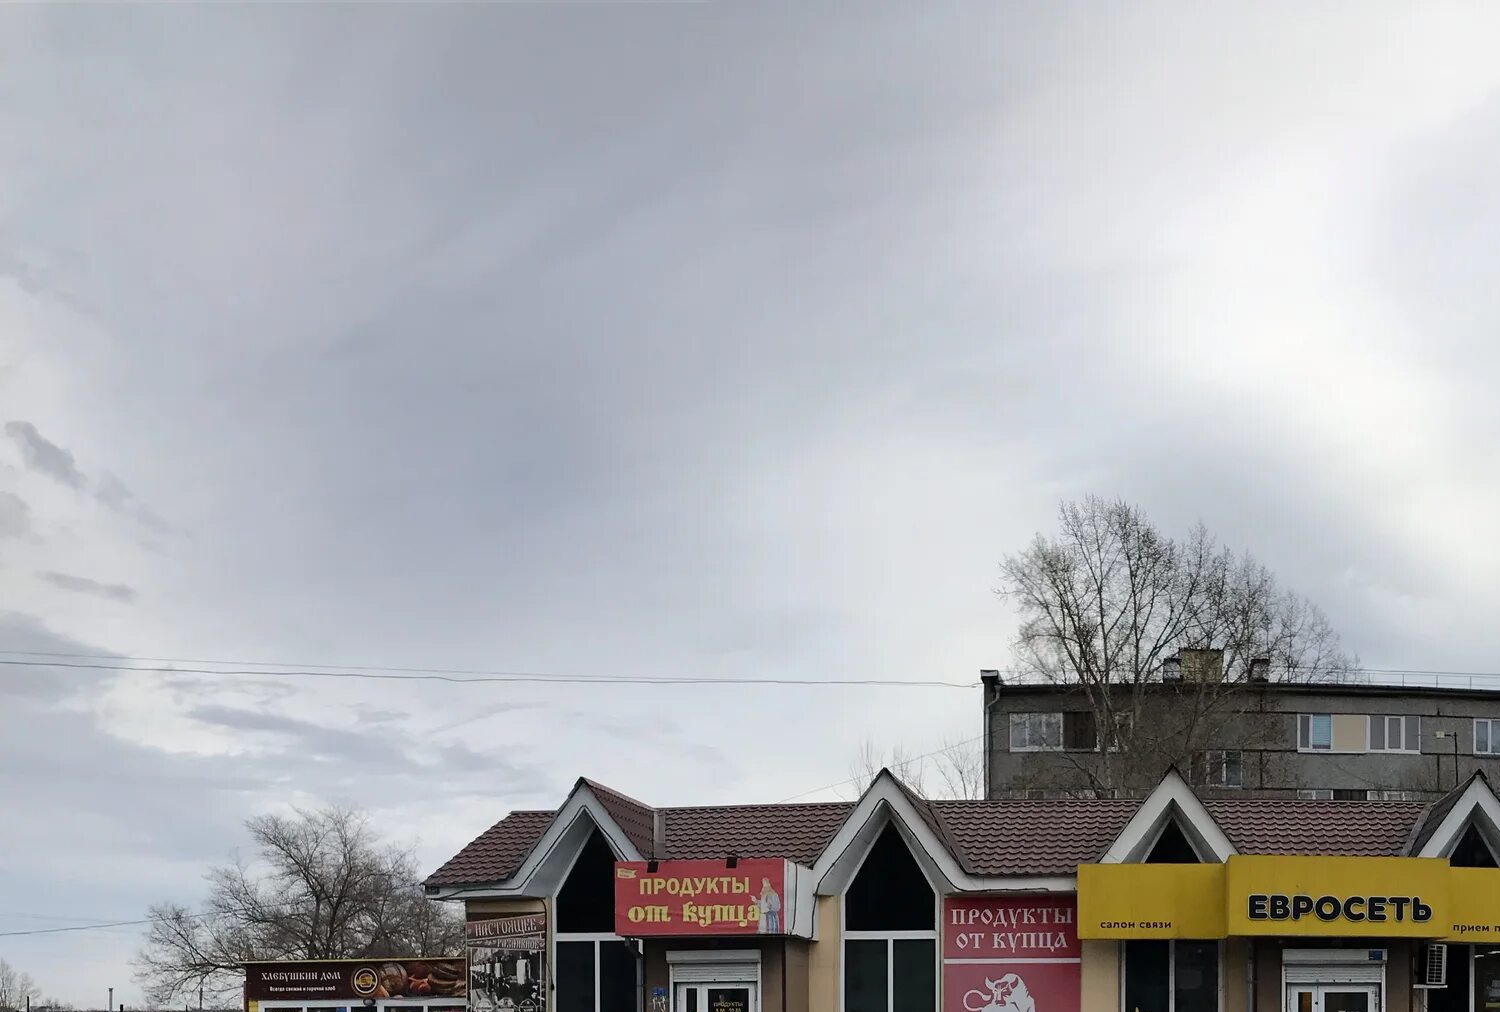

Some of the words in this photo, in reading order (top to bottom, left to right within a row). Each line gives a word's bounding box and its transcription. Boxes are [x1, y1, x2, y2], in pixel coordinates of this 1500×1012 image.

[639, 877, 750, 897] ПРОДУКТЫ
[627, 904, 671, 923] от
[682, 901, 760, 927] купца
[1247, 893, 1433, 922] ЕВРОСЕТЬ
[474, 917, 537, 937] НАСТОЯЩЕЕ
[951, 908, 1073, 929] ПРОДУКТЫ
[1100, 920, 1135, 929] салон
[1139, 920, 1172, 929] связи
[1452, 923, 1490, 934] прием
[955, 932, 985, 950] ОТ
[992, 932, 1069, 953] КУПЦА
[261, 972, 318, 982] ХЛЕБУШКИН
[320, 972, 341, 981] ДОМ
